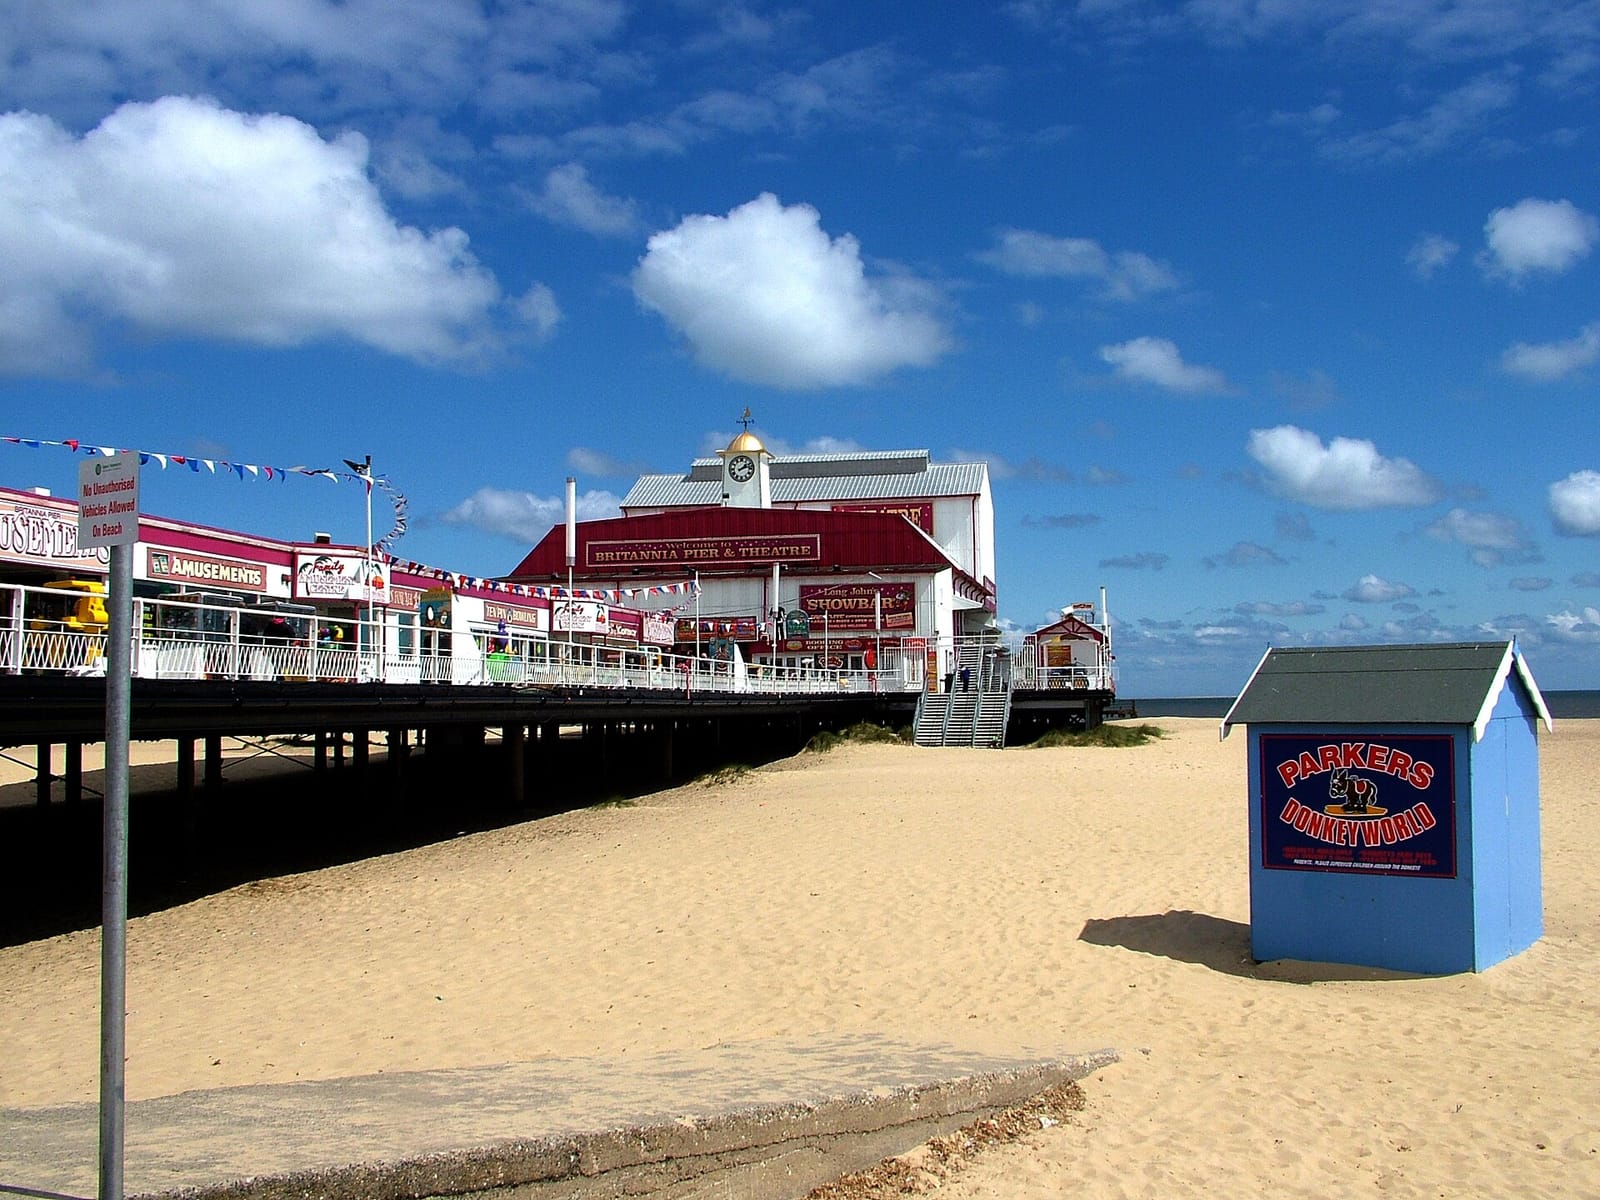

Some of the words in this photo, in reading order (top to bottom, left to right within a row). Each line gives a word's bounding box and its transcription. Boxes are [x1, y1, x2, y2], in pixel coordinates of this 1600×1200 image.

[83, 484, 92, 497] No
[93, 477, 135, 495] Unauthorised
[82, 505, 107, 518] Vehicles
[108, 498, 135, 515] Allowed
[92, 525, 102, 537] On
[103, 521, 122, 535] Beach
[594, 549, 679, 562] BRITANNIA
[683, 548, 720, 559] PIER
[723, 547, 736, 558] &
[738, 545, 811, 557] THEATRE
[665, 541, 718, 549] Welcome
[171, 555, 262, 585] AMUSEMENTS
[312, 559, 345, 574] Family
[486, 605, 497, 618] TEN
[1277, 743, 1434, 790] PARKERS
[1280, 797, 1437, 847] DONKEYWORLD
